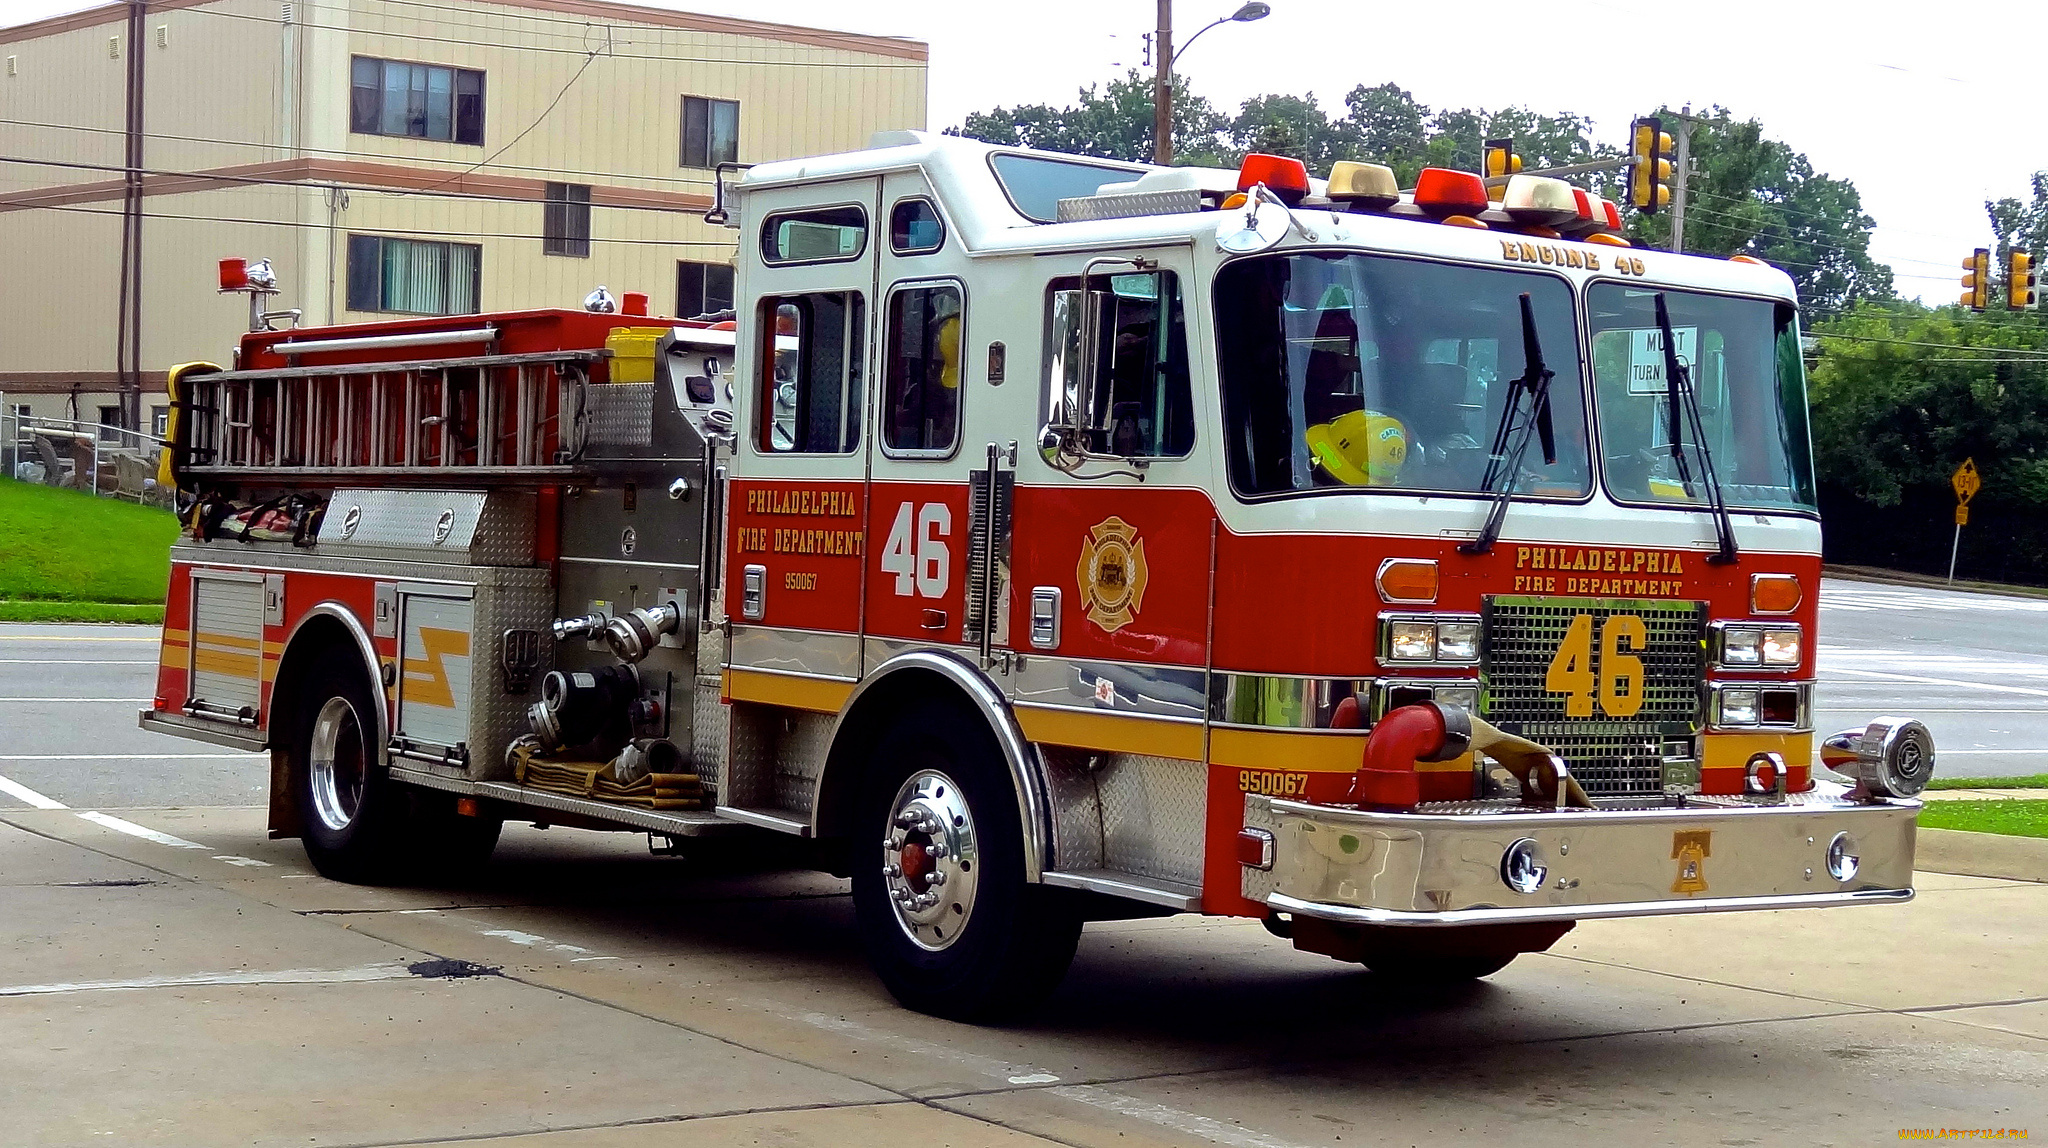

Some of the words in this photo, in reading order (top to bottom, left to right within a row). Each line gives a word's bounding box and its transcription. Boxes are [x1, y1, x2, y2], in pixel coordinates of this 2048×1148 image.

[1500, 240, 1600, 270] ENGINE
[1615, 255, 1645, 276] 46
[1647, 332, 1685, 351] MUT
[1633, 364, 1660, 380] TURN
[747, 490, 856, 516] PHILADELPHIA
[737, 527, 767, 553] FIRE
[774, 528, 863, 556] DEPARTMENT
[881, 501, 951, 599] 46
[1516, 547, 1684, 574] PHILADELPHIA
[785, 572, 817, 591] 950067
[1514, 575, 1556, 592] FIRE
[1567, 577, 1683, 596] DEPARTMENT
[1546, 614, 1646, 717] 46
[1239, 770, 1308, 796] 950067
